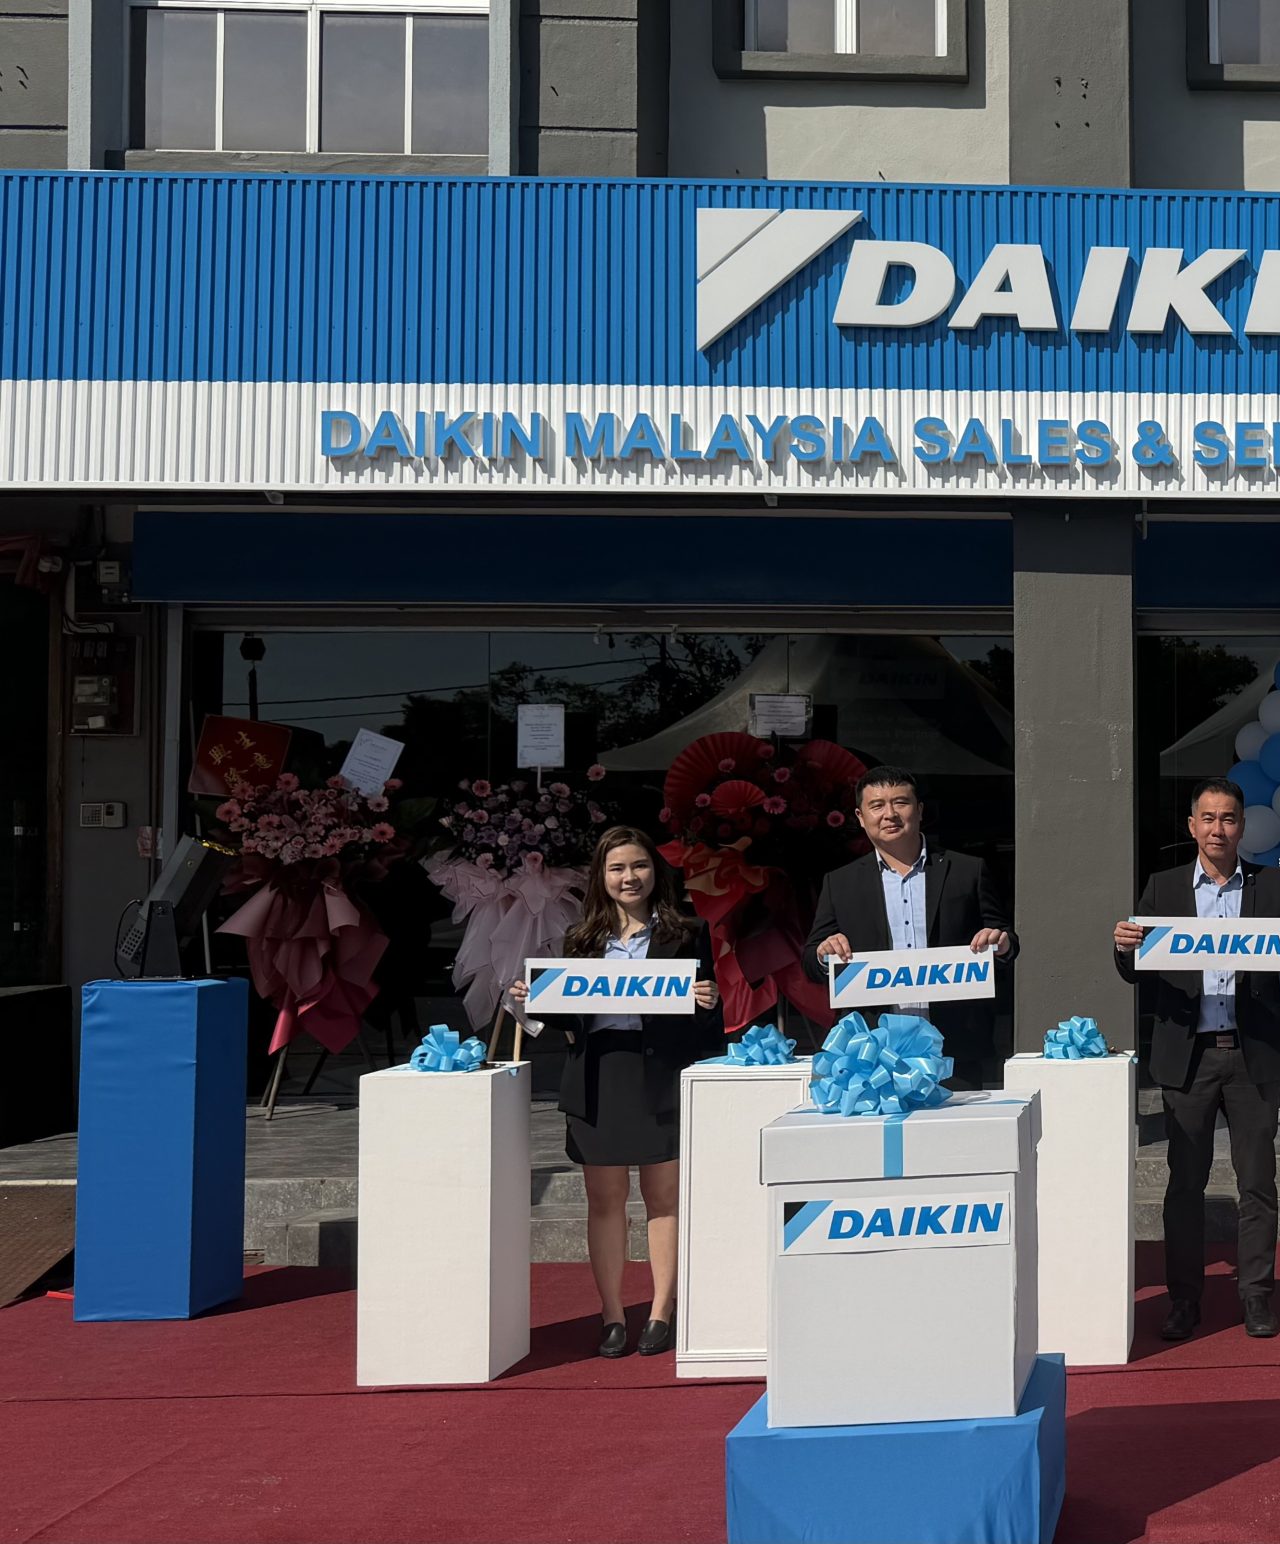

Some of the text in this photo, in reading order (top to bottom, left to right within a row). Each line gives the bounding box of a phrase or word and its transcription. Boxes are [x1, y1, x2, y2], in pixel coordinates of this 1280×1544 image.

[321, 410, 541, 459] DAIKIN
[565, 412, 895, 463] MALAYSIA
[913, 417, 1113, 465] SALES
[1132, 420, 1174, 467] &
[562, 975, 692, 998] DAIKIN
[865, 960, 990, 990] DAIKIN
[828, 1202, 1003, 1241] DAIKIN
